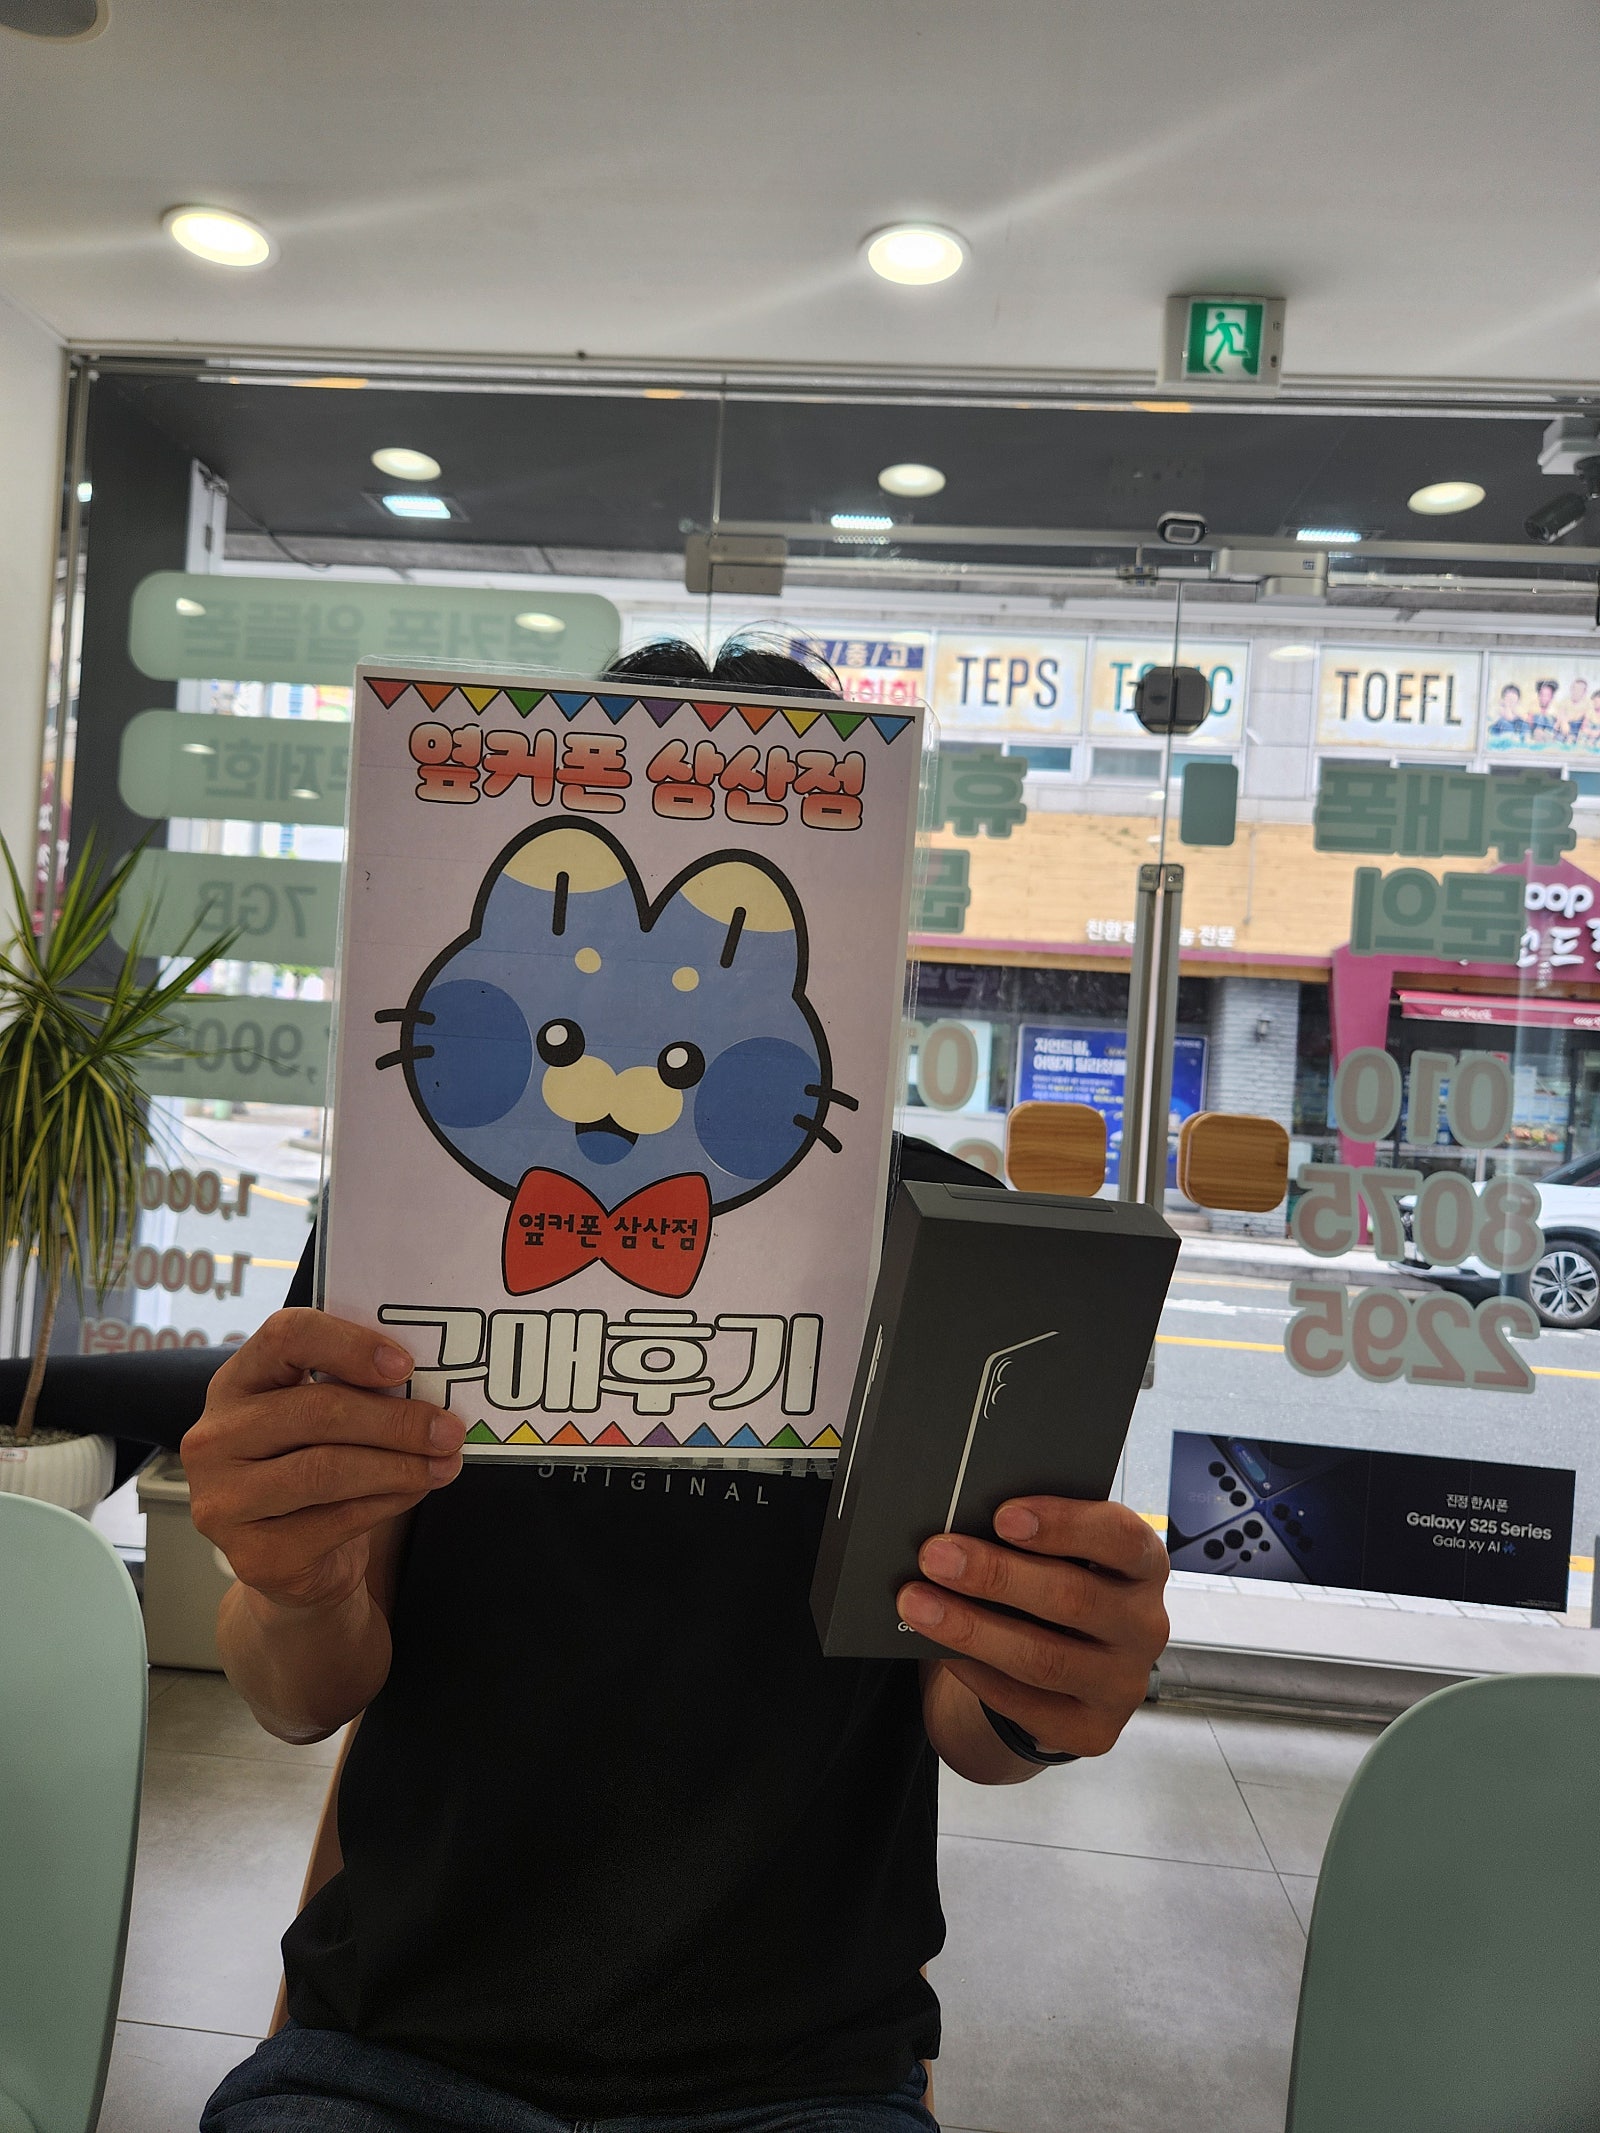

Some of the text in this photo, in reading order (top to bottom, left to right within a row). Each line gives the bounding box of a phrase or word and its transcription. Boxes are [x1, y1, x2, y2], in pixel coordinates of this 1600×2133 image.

[956, 656, 1059, 711] TEPS
[1335, 669, 1463, 727] TOEFL
[409, 721, 632, 814] 옆커폰
[646, 739, 866, 831] 삼산점
[518, 1212, 698, 1252] 옆커폰 삼산점
[378, 1303, 823, 1416] 구매후기
[1406, 1511, 1552, 1540] Galaxy S25 Series
